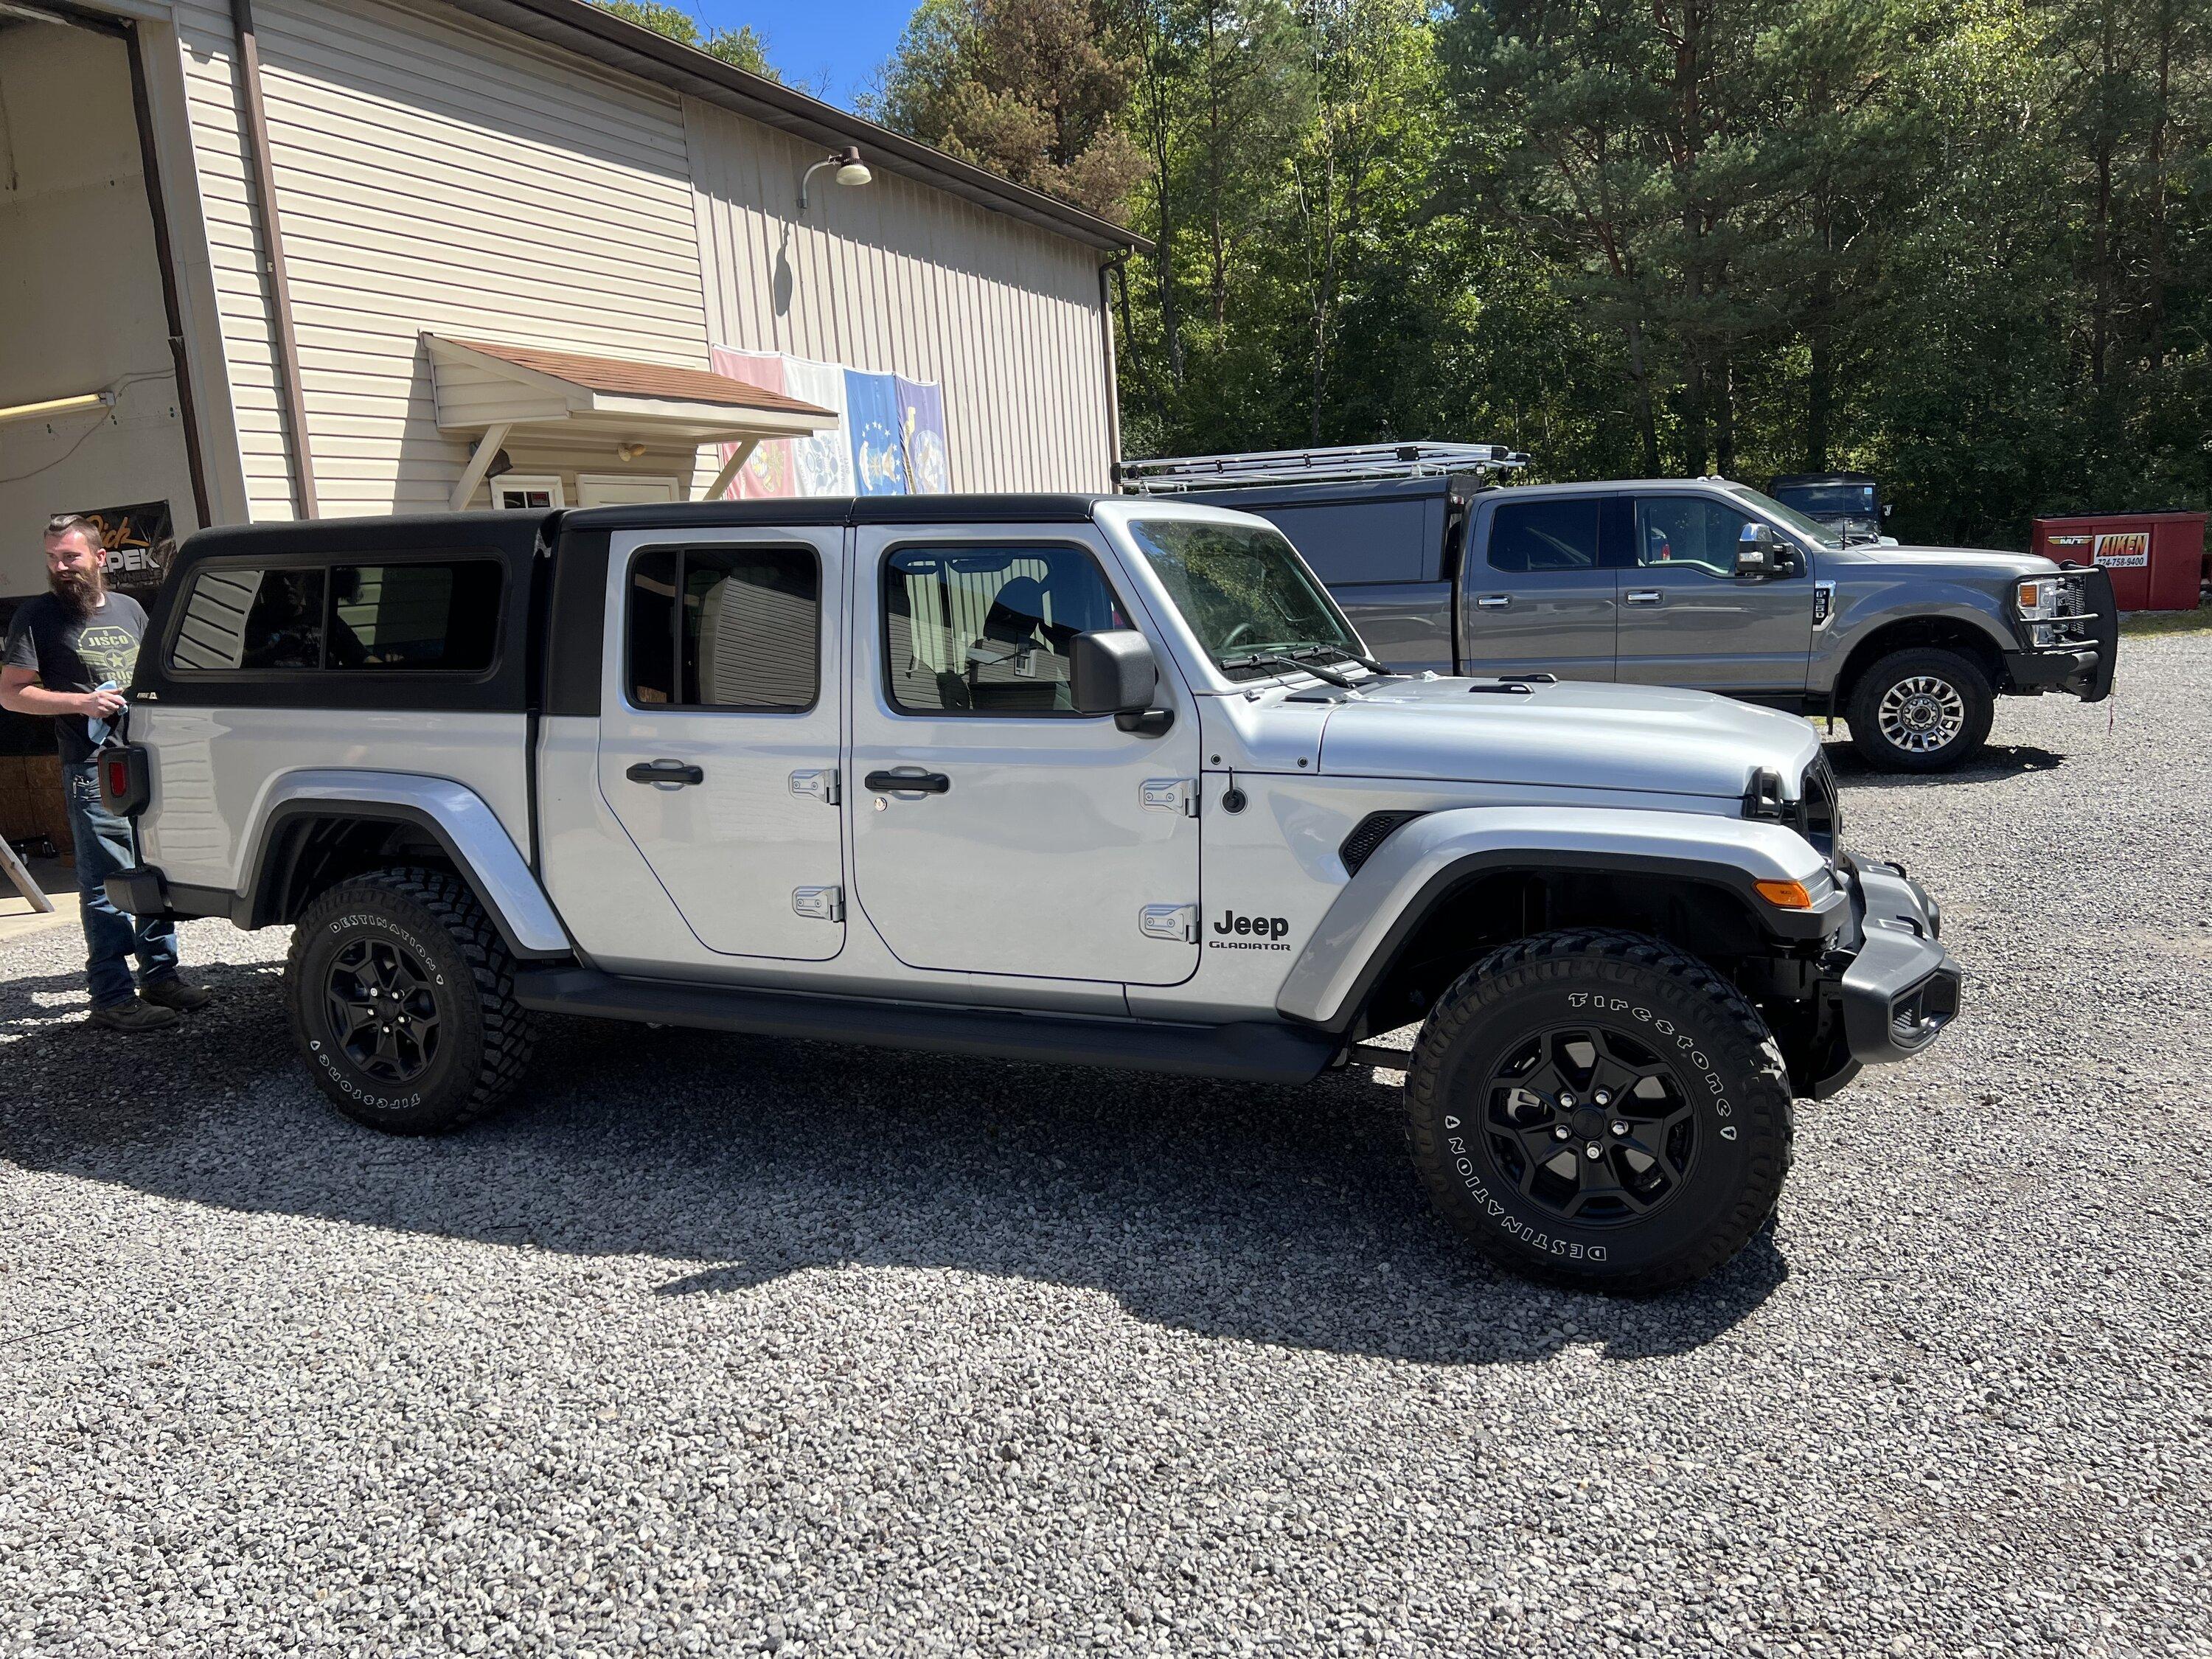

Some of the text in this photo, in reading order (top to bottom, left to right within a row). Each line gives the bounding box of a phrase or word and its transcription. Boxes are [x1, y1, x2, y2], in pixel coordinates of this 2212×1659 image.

[102, 546, 161, 574] PEK
[2096, 535, 2146, 557] AIKEN
[88, 635, 129, 647] JISCO
[1214, 910, 1289, 941] Jeep
[330, 914, 436, 971] DESTINATION
[1208, 941, 1291, 951] GLADIATOR
[1448, 1136, 1607, 1262] DESTINATION
